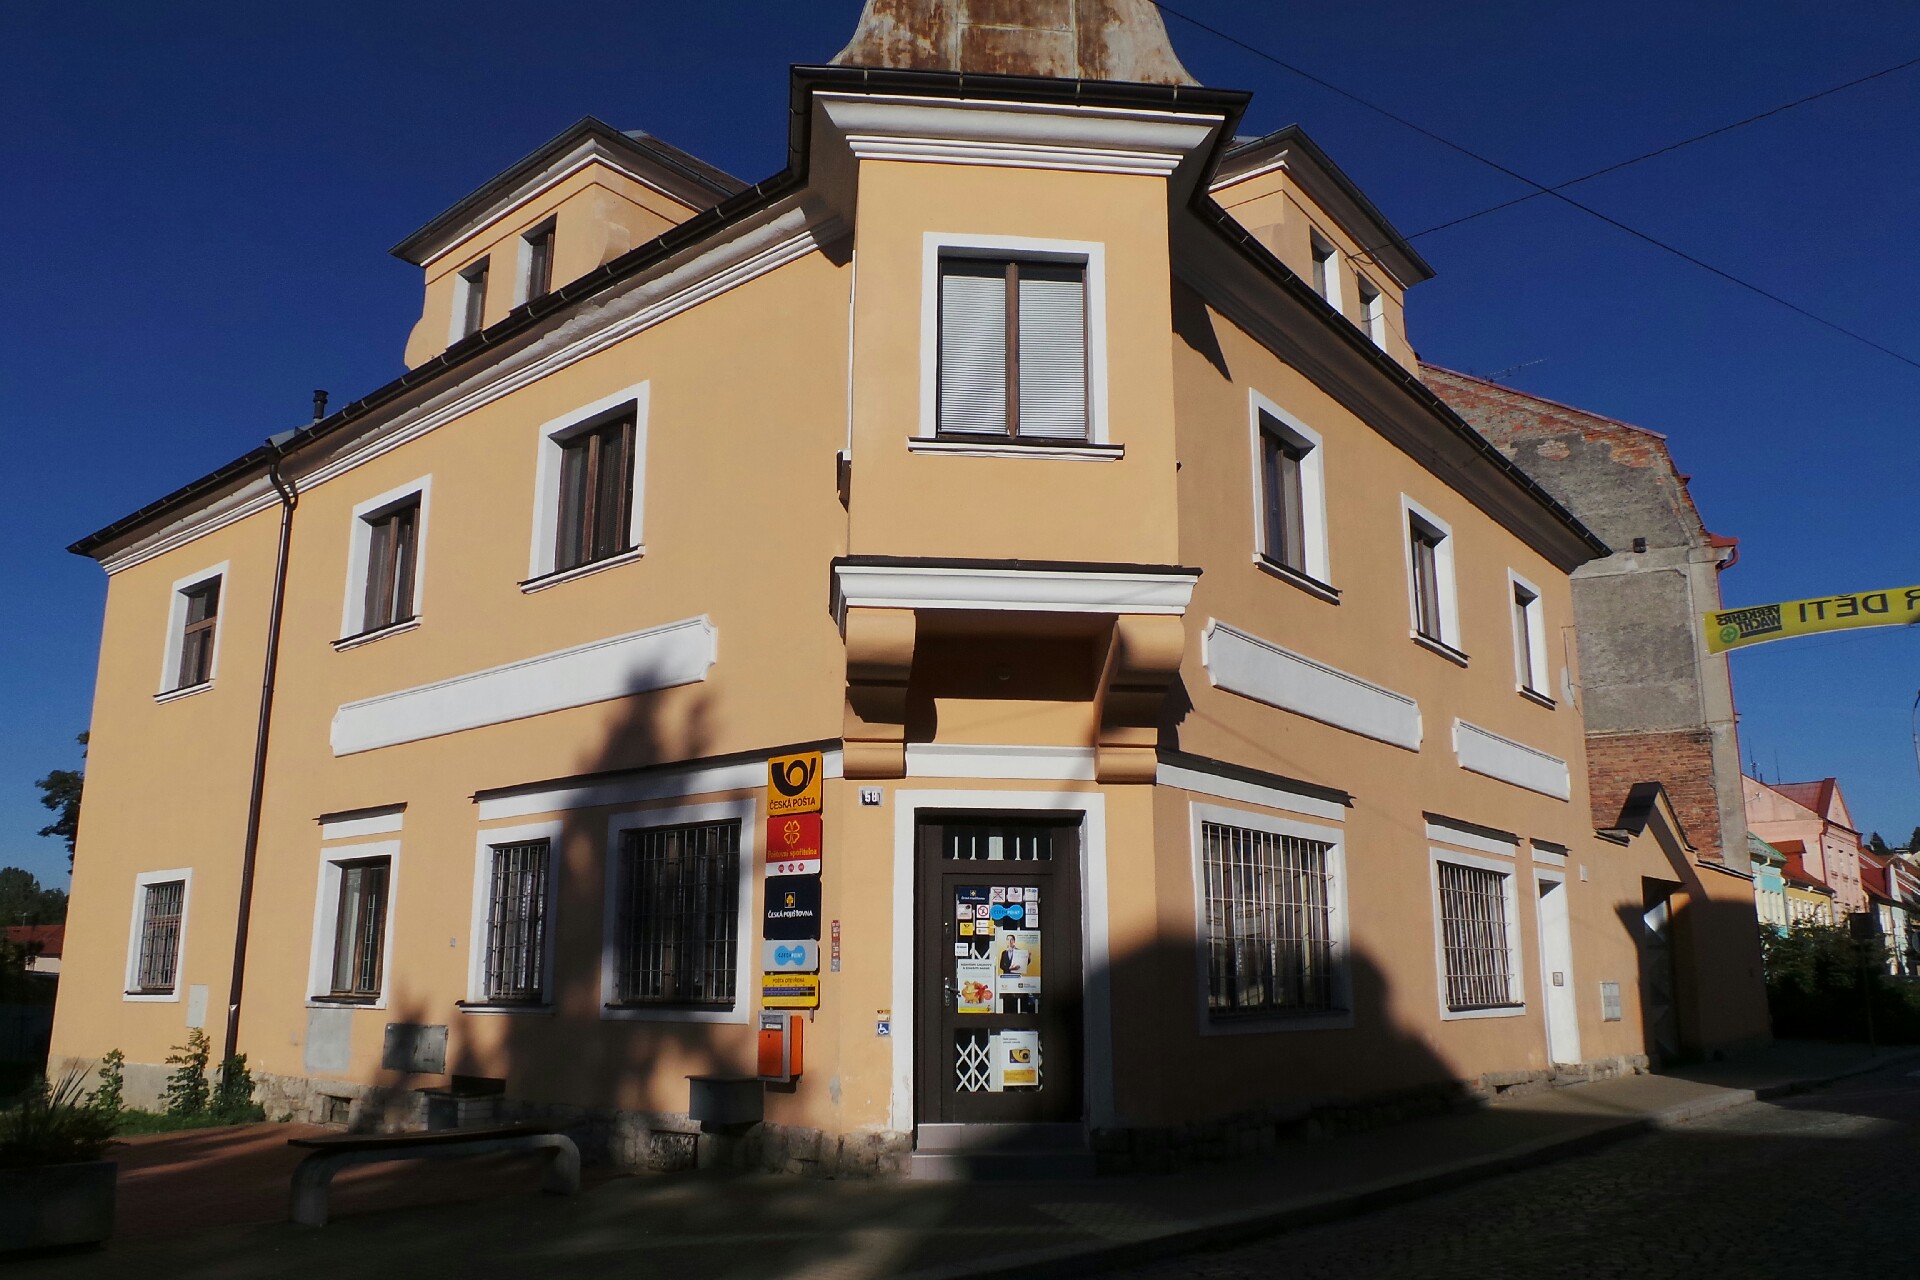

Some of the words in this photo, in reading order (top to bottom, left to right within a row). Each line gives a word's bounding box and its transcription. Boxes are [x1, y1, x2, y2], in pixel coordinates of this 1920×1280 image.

[769, 797, 792, 810] ČESKÁ
[792, 795, 816, 808] POŠTA
[864, 790, 878, 803] 58
[768, 909, 784, 919] ČESKÁ
